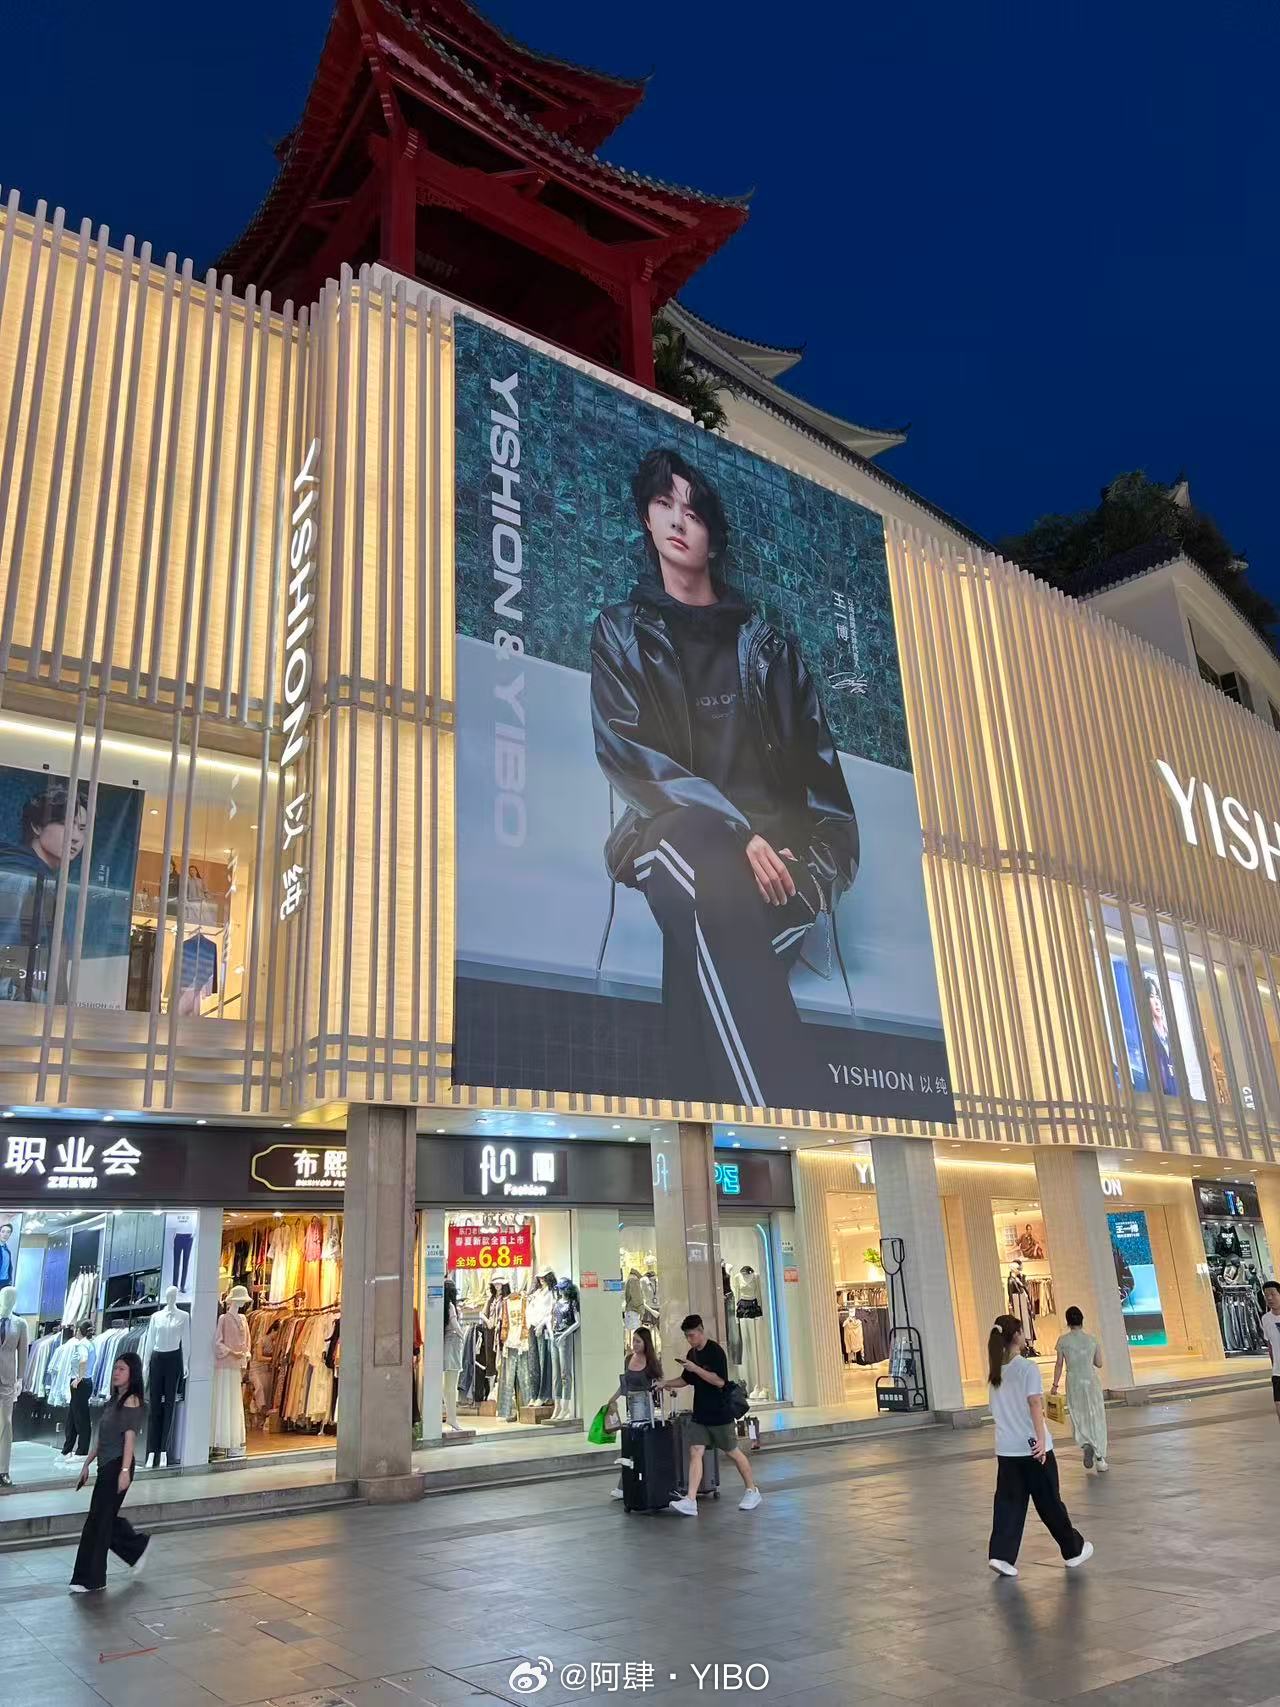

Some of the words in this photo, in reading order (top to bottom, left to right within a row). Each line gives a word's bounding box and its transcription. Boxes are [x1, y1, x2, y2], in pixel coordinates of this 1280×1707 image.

[490, 372, 523, 621] YISHION
[280, 437, 319, 767] YISHION
[493, 629, 525, 660] &
[494, 672, 527, 847] YIBO
[828, 1063, 914, 1092] YISHION
[920, 1075, 948, 1095] 以纯
[4, 1136, 142, 1176] 职业会
[504, 1183, 546, 1196] Fashion
